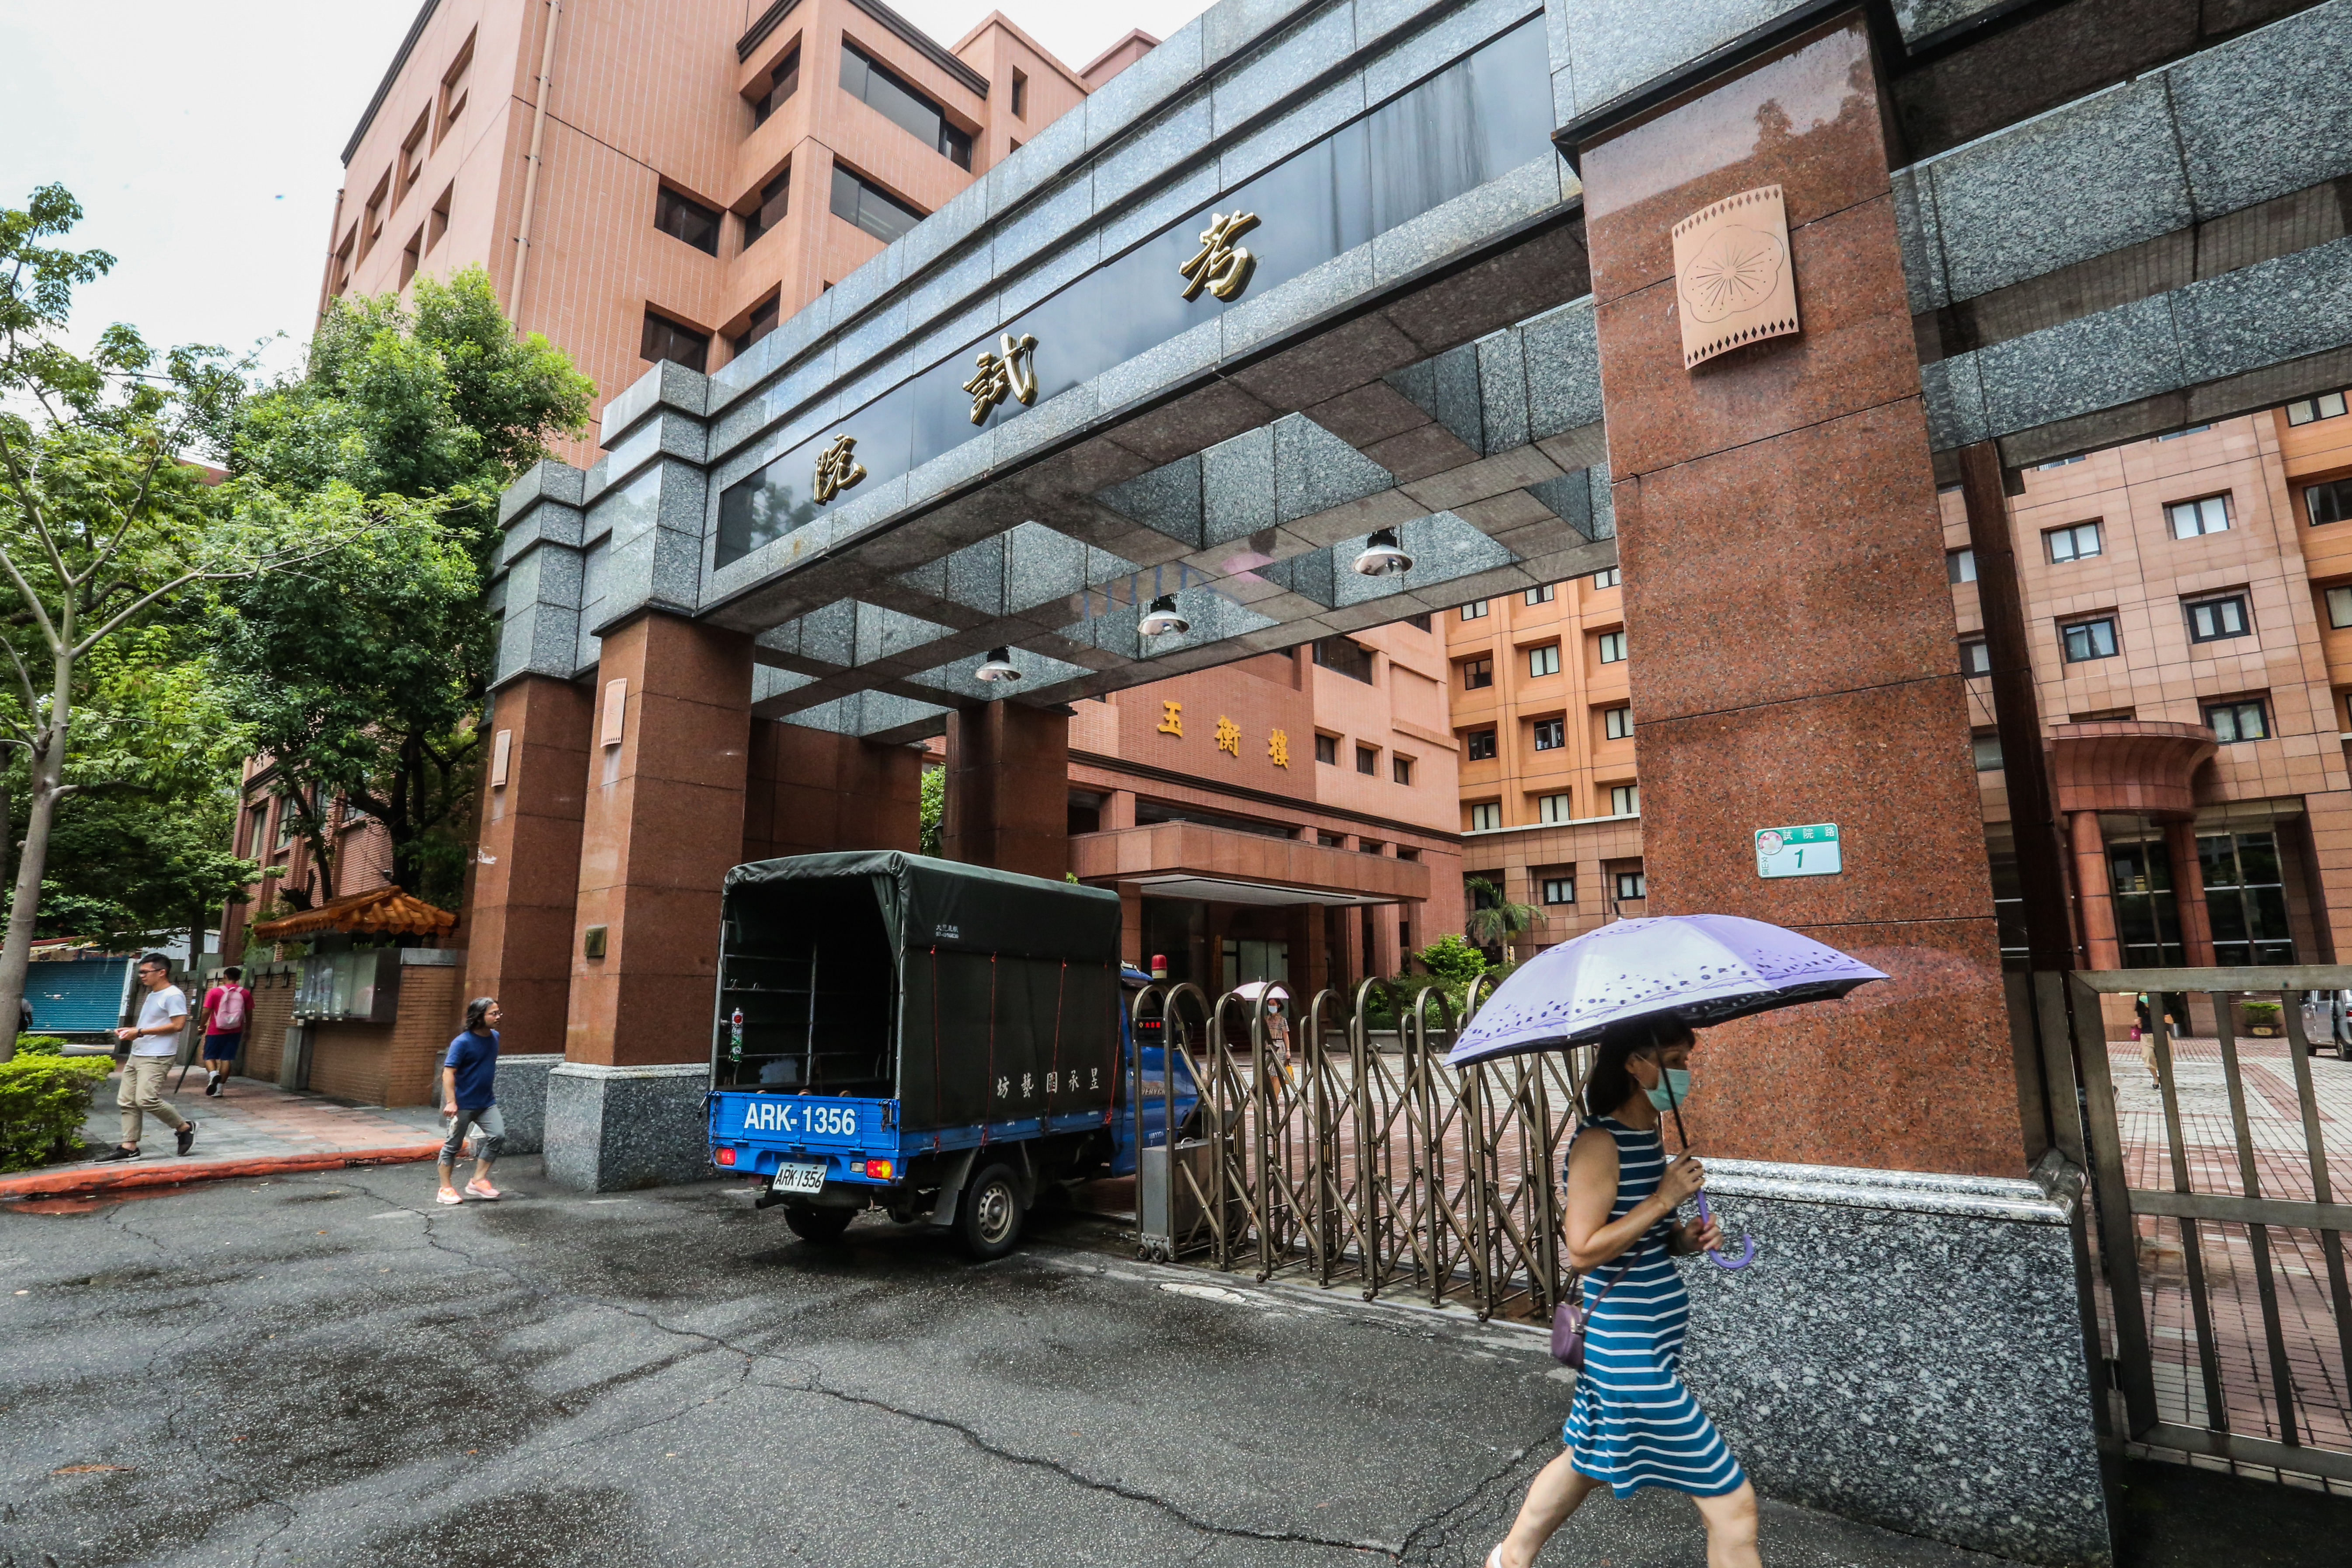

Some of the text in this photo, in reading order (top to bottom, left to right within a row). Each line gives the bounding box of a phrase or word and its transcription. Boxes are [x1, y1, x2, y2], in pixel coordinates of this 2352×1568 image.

[814, 210, 1261, 506] 考試院
[1157, 700, 1289, 769] 玉衡樓
[1782, 826, 1835, 841] 試院路
[1761, 856, 1769, 875] 文山區
[1794, 848, 1804, 869] 1
[744, 1103, 856, 1136] ARK-1356
